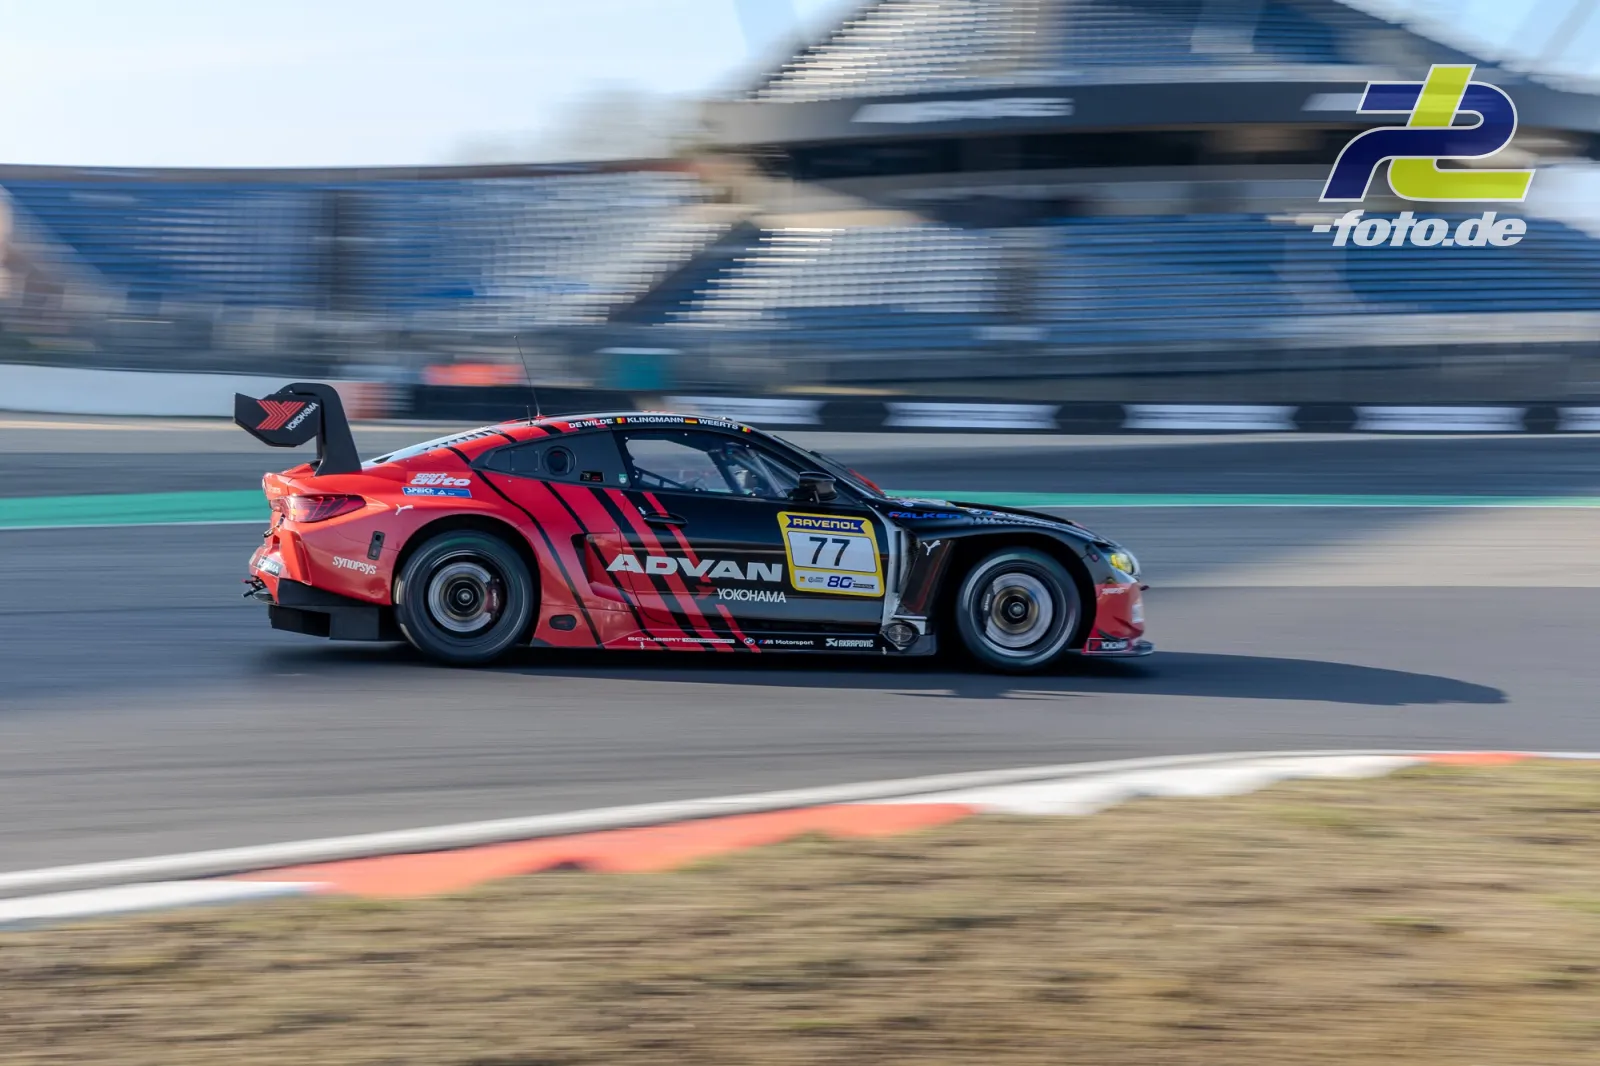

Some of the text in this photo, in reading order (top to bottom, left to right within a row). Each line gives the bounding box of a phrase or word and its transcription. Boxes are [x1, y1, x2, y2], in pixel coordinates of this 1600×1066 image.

[285, 402, 320, 431] YOKOHAMA
[583, 418, 614, 427] WILDE
[627, 416, 684, 424] KLINGMANN
[698, 418, 739, 430] WEERTS
[410, 477, 471, 486] auto
[793, 518, 859, 530] RAVENOL
[809, 536, 851, 567] 77
[606, 553, 783, 582] ADVAN
[717, 588, 787, 603] YOKOHAMA
